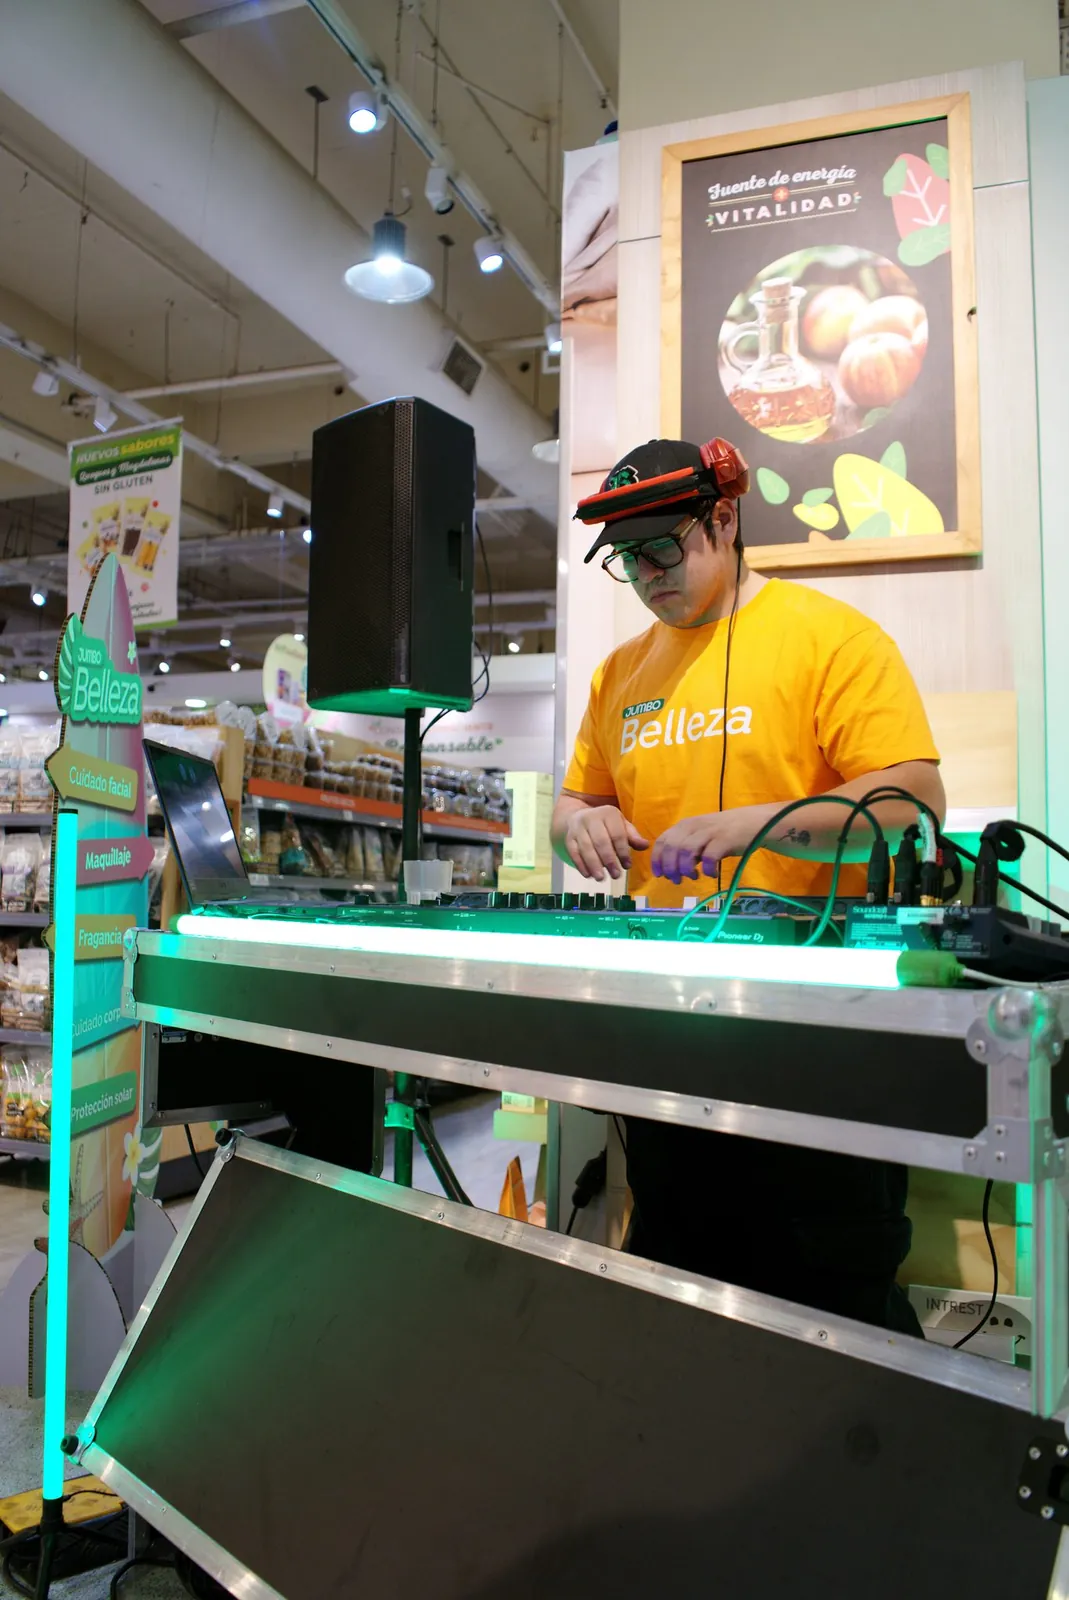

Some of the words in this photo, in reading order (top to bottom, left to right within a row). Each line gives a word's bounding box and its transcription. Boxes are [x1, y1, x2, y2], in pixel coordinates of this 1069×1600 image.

[707, 174, 766, 200] Fuente
[768, 169, 791, 187] de
[792, 164, 857, 185] energía
[715, 193, 852, 225] VITALIDAD
[76, 446, 120, 464] NUEVOS
[121, 434, 175, 454] sabores
[94, 483, 110, 495] SIN
[113, 474, 153, 491] GLUTEN
[77, 647, 102, 665] JUMBO
[73, 666, 140, 716] Belleza
[625, 699, 662, 718] JUMBO
[620, 705, 753, 755] Belleza
[69, 765, 107, 792] Cuidado
[108, 775, 132, 799] facial
[85, 846, 131, 871] Maquillaje
[717, 931, 752, 941] Pioneer
[71, 1092, 114, 1121] Protección
[114, 1087, 134, 1105] solar
[926, 1297, 984, 1315] INTREST
